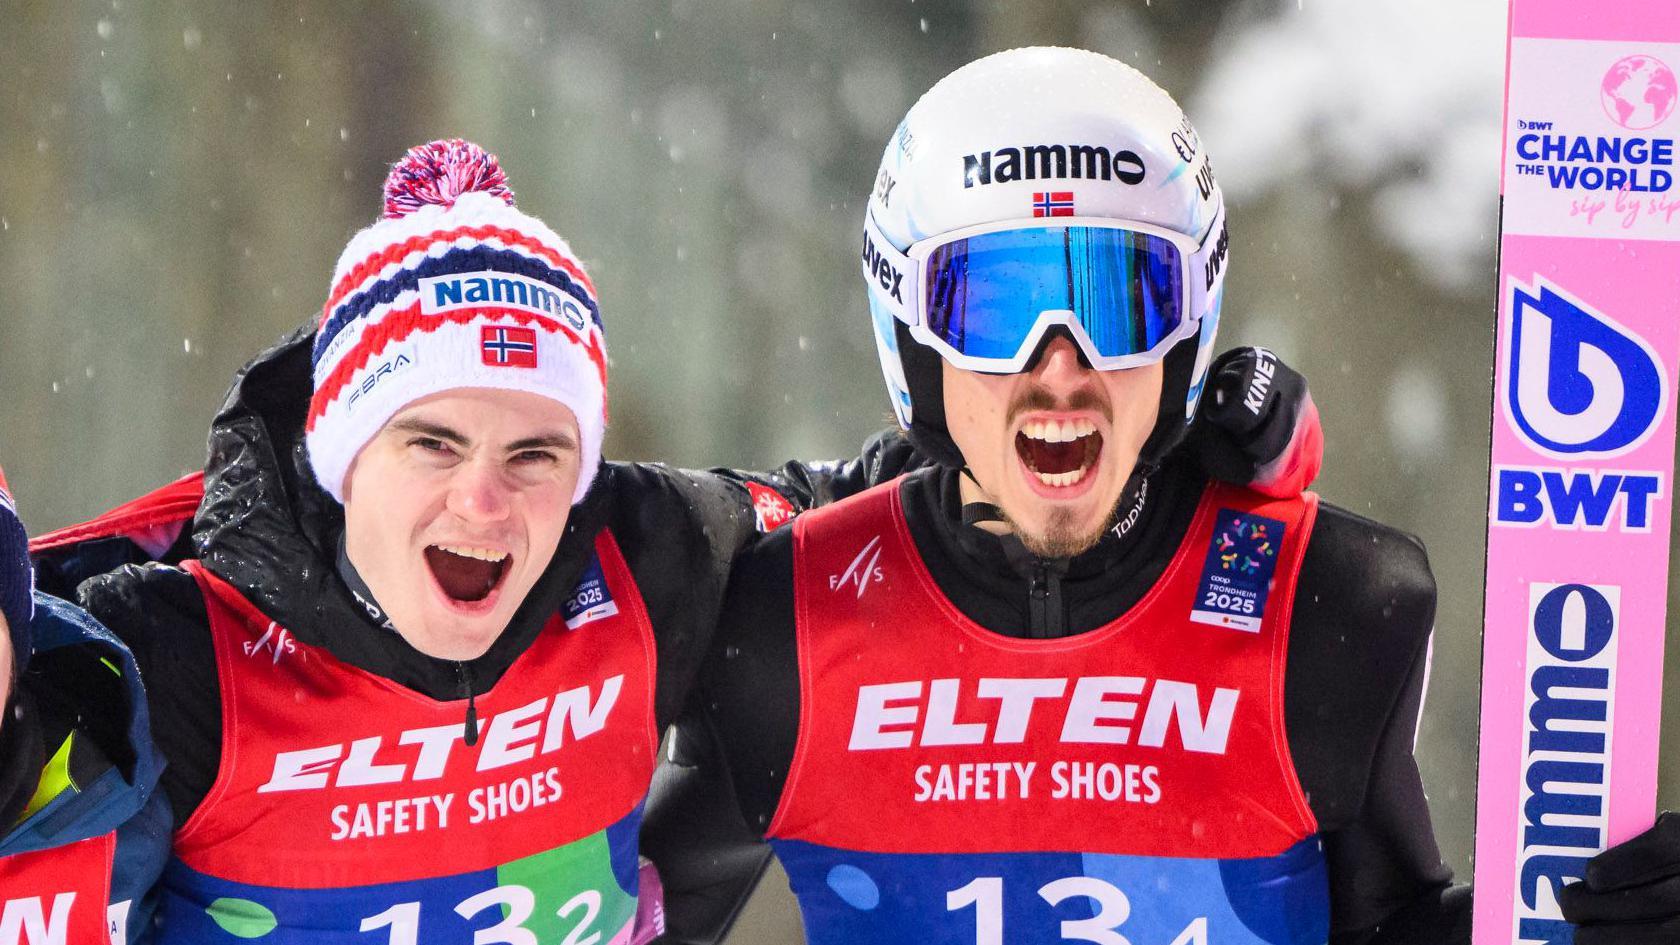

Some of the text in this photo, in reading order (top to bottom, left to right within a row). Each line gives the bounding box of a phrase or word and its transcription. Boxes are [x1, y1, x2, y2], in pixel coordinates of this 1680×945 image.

[1528, 121, 1553, 131] BWT
[963, 145, 1146, 188] Nammo
[1516, 134, 1673, 165] CHANGE
[1516, 164, 1673, 192] THE WORLD
[1570, 196, 1606, 225] sip
[1615, 181, 1646, 229] by
[862, 229, 904, 305] uvex
[433, 277, 585, 331] Nammo
[1497, 469, 1659, 529] BWT
[566, 587, 603, 612] 2025
[1209, 584, 1257, 599] TRONDHEIM
[1210, 575, 1231, 584] coop
[1204, 591, 1255, 614] 2025
[257, 674, 624, 793] ELTEN
[848, 676, 1240, 755] ELTEN
[330, 767, 563, 841] SAFETY SHOES
[914, 761, 1161, 804] SAFETY SHOES
